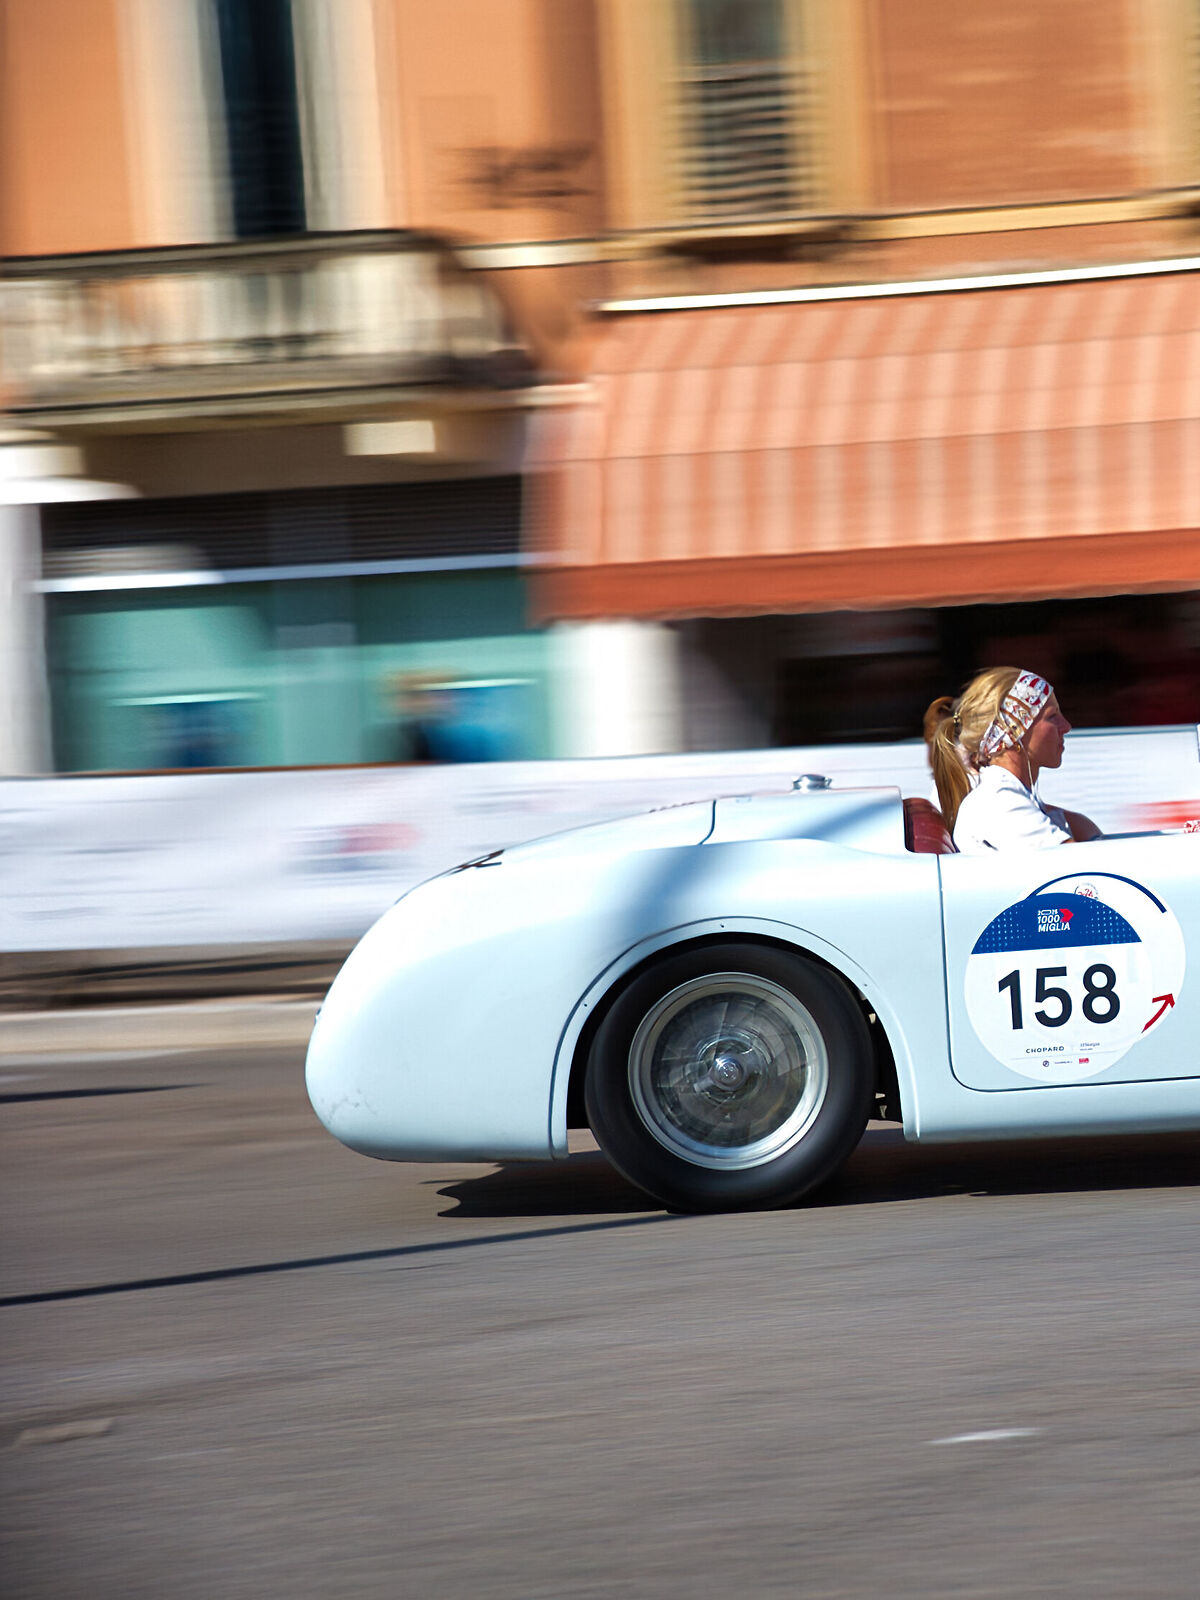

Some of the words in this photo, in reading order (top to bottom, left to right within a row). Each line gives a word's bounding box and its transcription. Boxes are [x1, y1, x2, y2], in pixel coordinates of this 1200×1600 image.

[1037, 914, 1060, 924] 1000
[1038, 922, 1071, 933] MIGLIA
[998, 963, 1120, 1030] 158
[1025, 1045, 1065, 1054] CHOPARD
